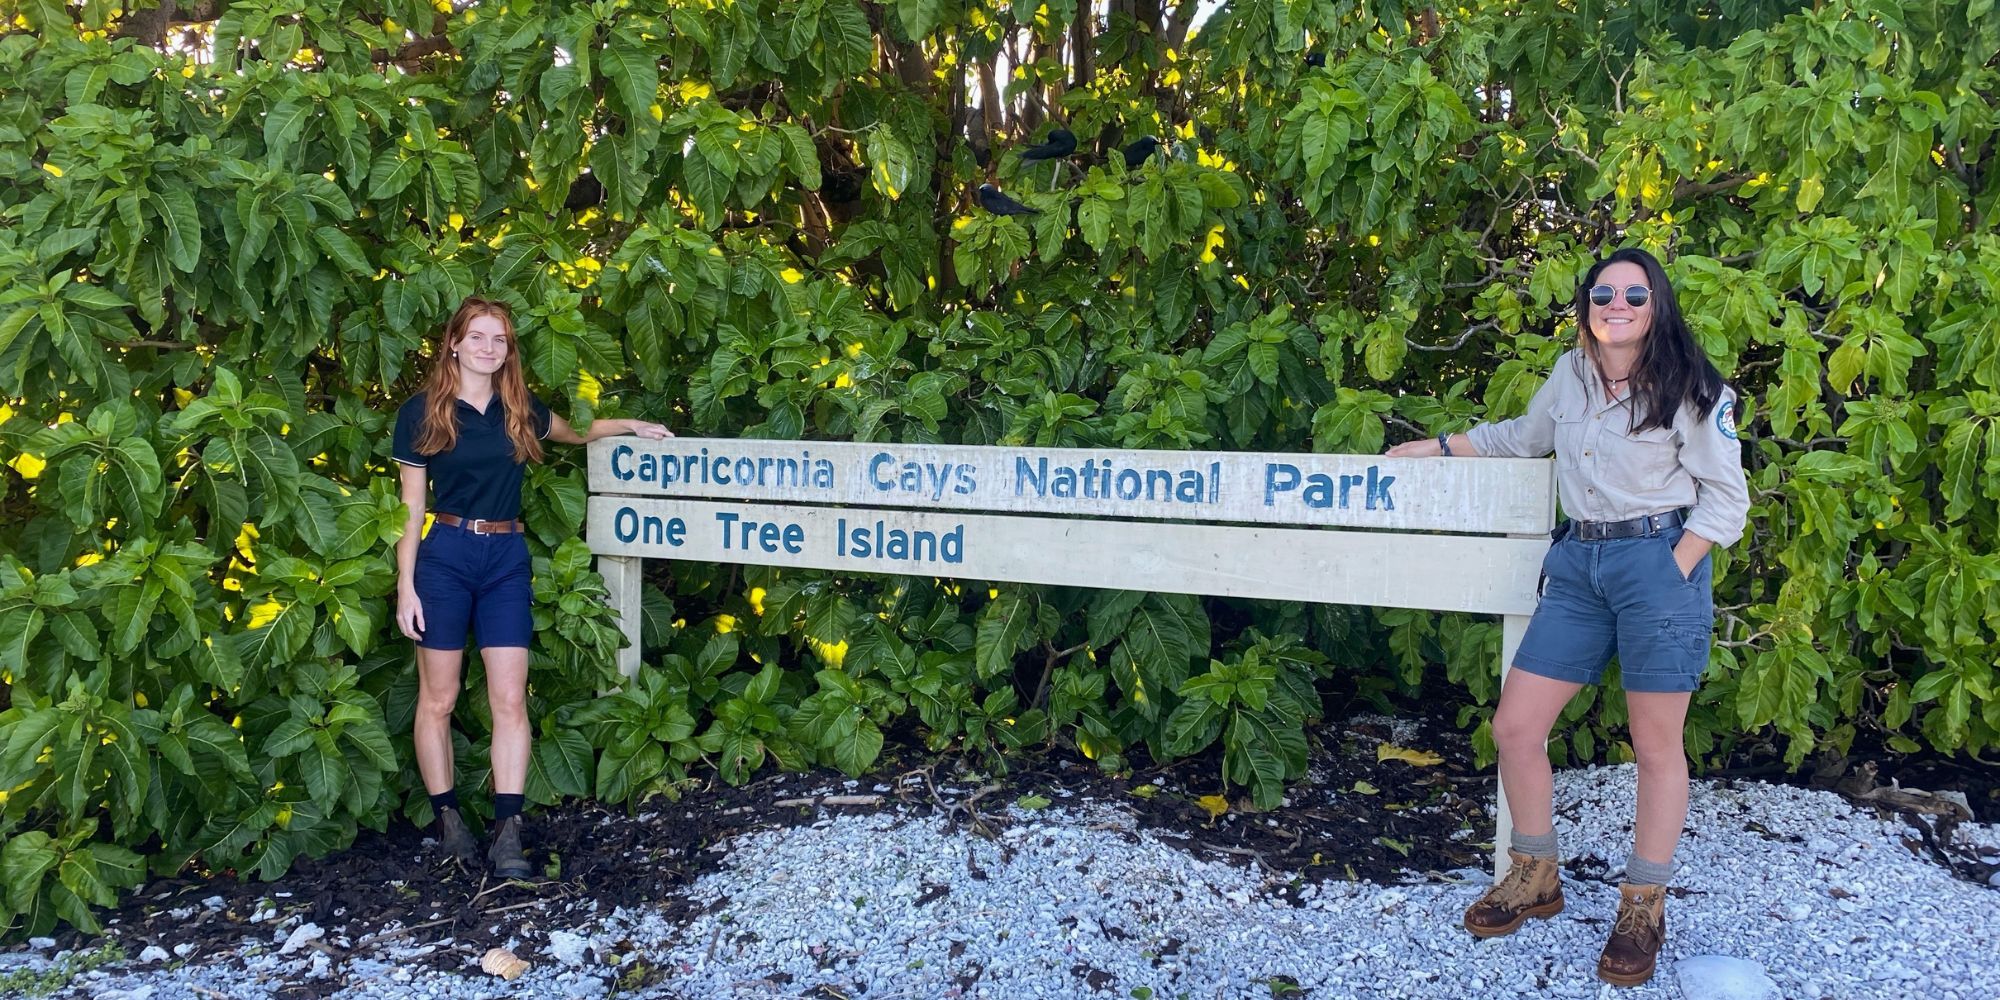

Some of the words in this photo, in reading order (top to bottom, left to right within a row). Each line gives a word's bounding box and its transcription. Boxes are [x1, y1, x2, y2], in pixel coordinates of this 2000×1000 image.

[611, 444, 835, 489] Capricornia
[869, 452, 977, 500] Cays
[1015, 456, 1220, 504] National
[1264, 462, 1396, 511] Park
[614, 506, 687, 547] One
[716, 512, 805, 553] Tree
[837, 518, 964, 564] Island
